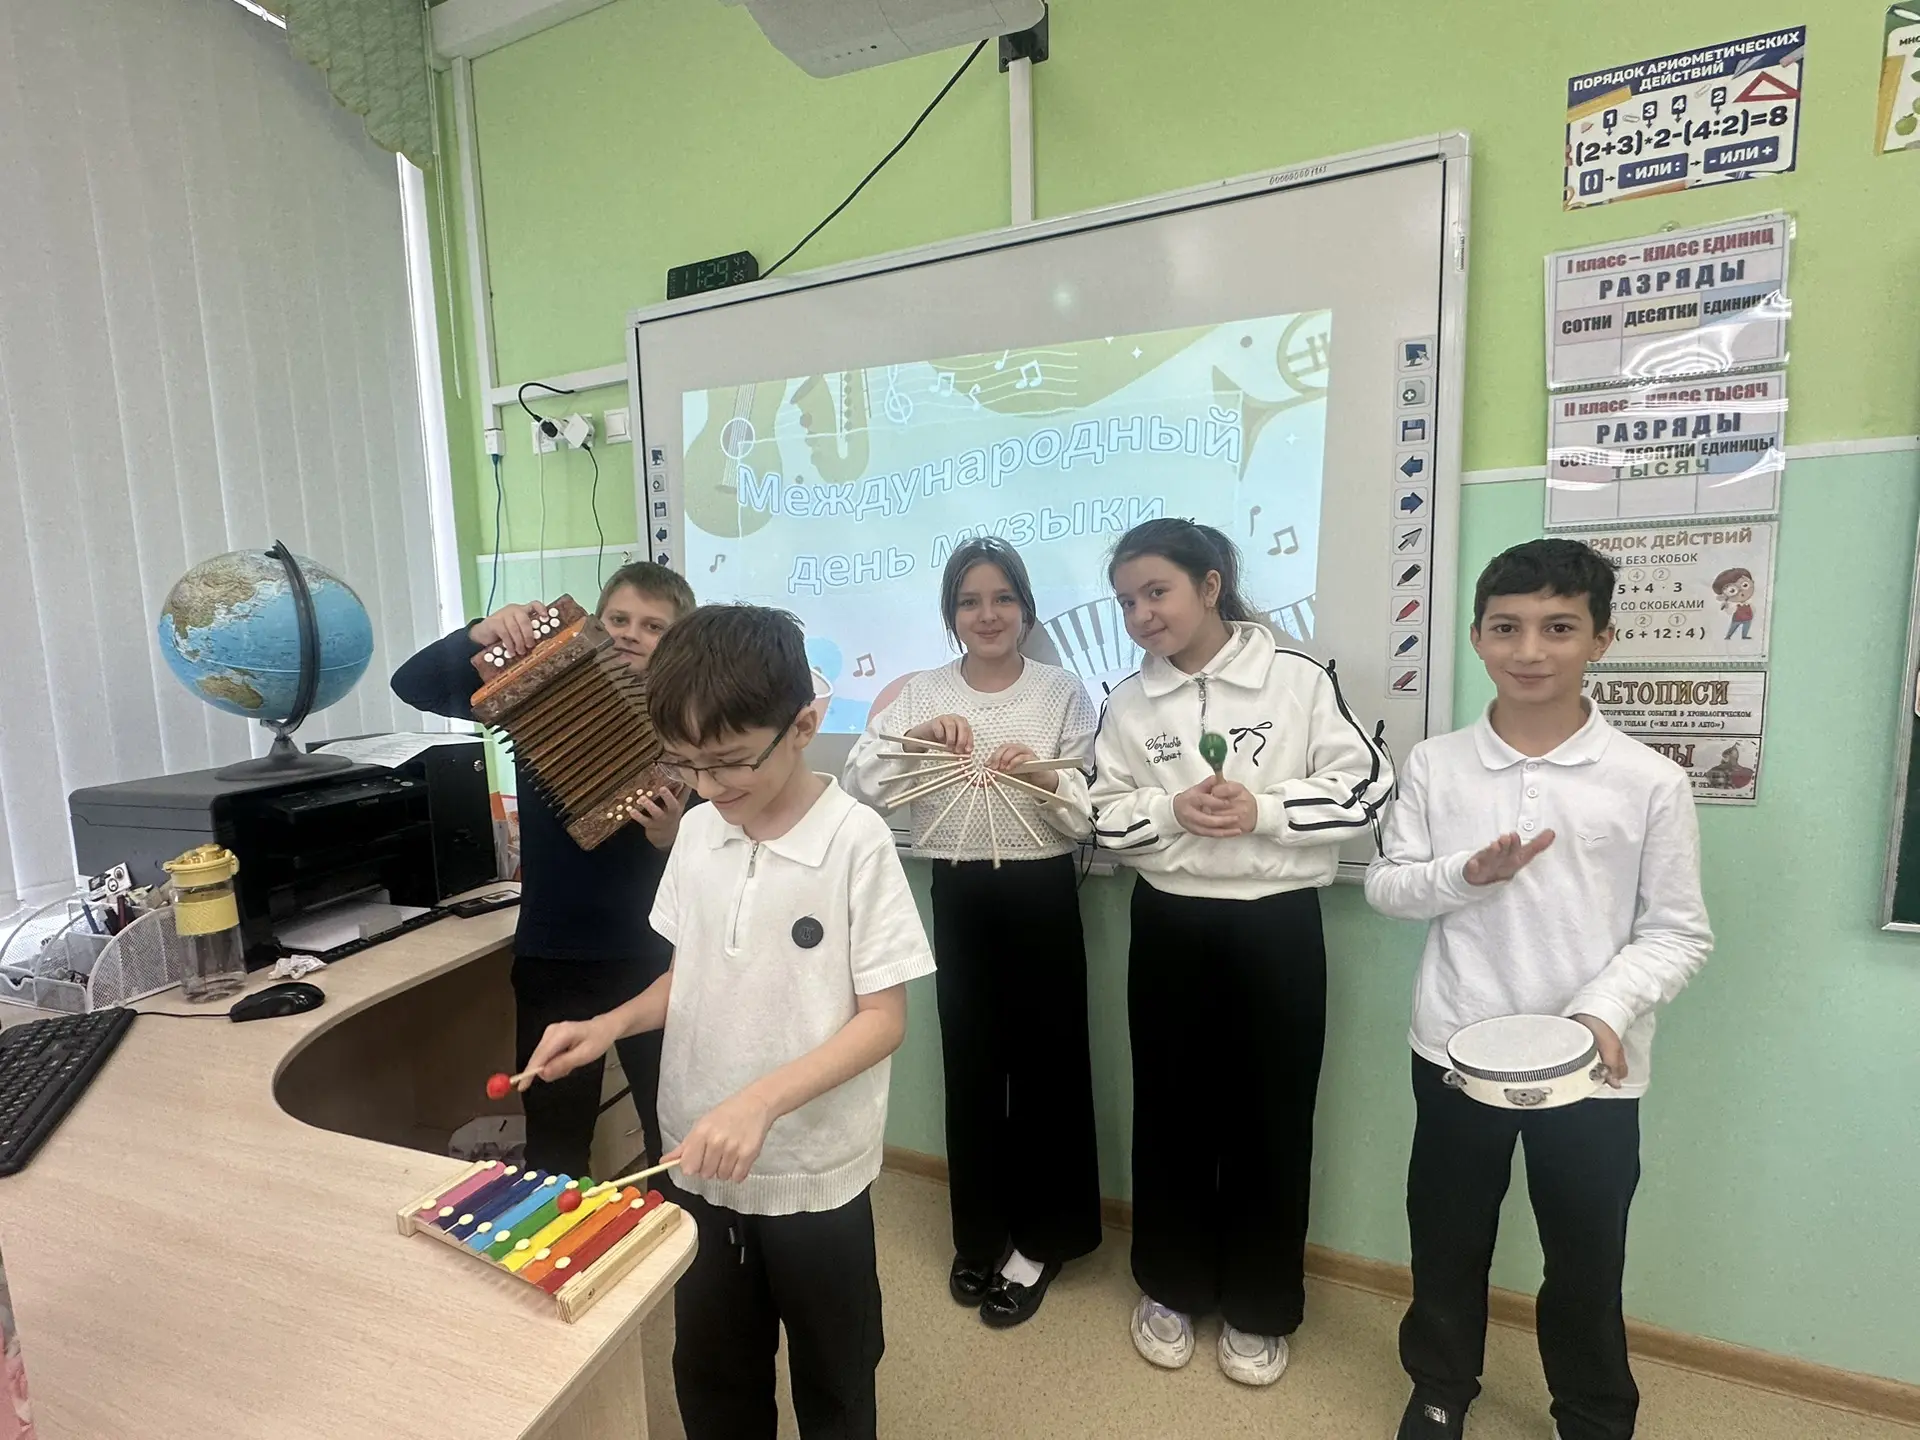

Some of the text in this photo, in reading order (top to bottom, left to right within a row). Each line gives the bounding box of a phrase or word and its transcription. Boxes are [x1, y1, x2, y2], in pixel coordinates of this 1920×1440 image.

[1573, 31, 1800, 91] ПОРЯДОК АРИФМЕТИЧЕСКИХ
[1639, 61, 1724, 92] ДЕЙСТВИЙ
[1605, 90, 1725, 125] 1 3 4 2
[1635, 162, 1672, 180] ИЛИ
[1720, 146, 1759, 165] ИЛИ
[1576, 254, 1627, 272] класс
[1643, 241, 1699, 263] КЛАСС
[1703, 227, 1774, 255] ЕДИНИЦ
[1599, 259, 1746, 300] РАЗРЯДЫ
[1561, 315, 1612, 335] СОТНИ
[1624, 302, 1698, 328] ДЕСЯТКИ
[1578, 399, 1628, 416] класс
[1704, 381, 1769, 402] ТЫСЯЧ
[1596, 412, 1741, 444] РАЗРЯДЫ
[1701, 437, 1774, 456] ЕДИНИЦЫ
[737, 406, 1241, 522] Международный
[1612, 458, 1710, 479] ТЫСЯЧ
[787, 498, 1164, 595] день музыки
[1650, 527, 1752, 550] ДЕЙСТВИЙ
[1626, 556, 1647, 565] БЕЗ
[1650, 552, 1698, 564] СКОБОК
[1620, 601, 1636, 611] СО
[1639, 599, 1705, 611] СКОБКАМИ
[1591, 680, 1729, 706] ЛЕТОПИСИ
